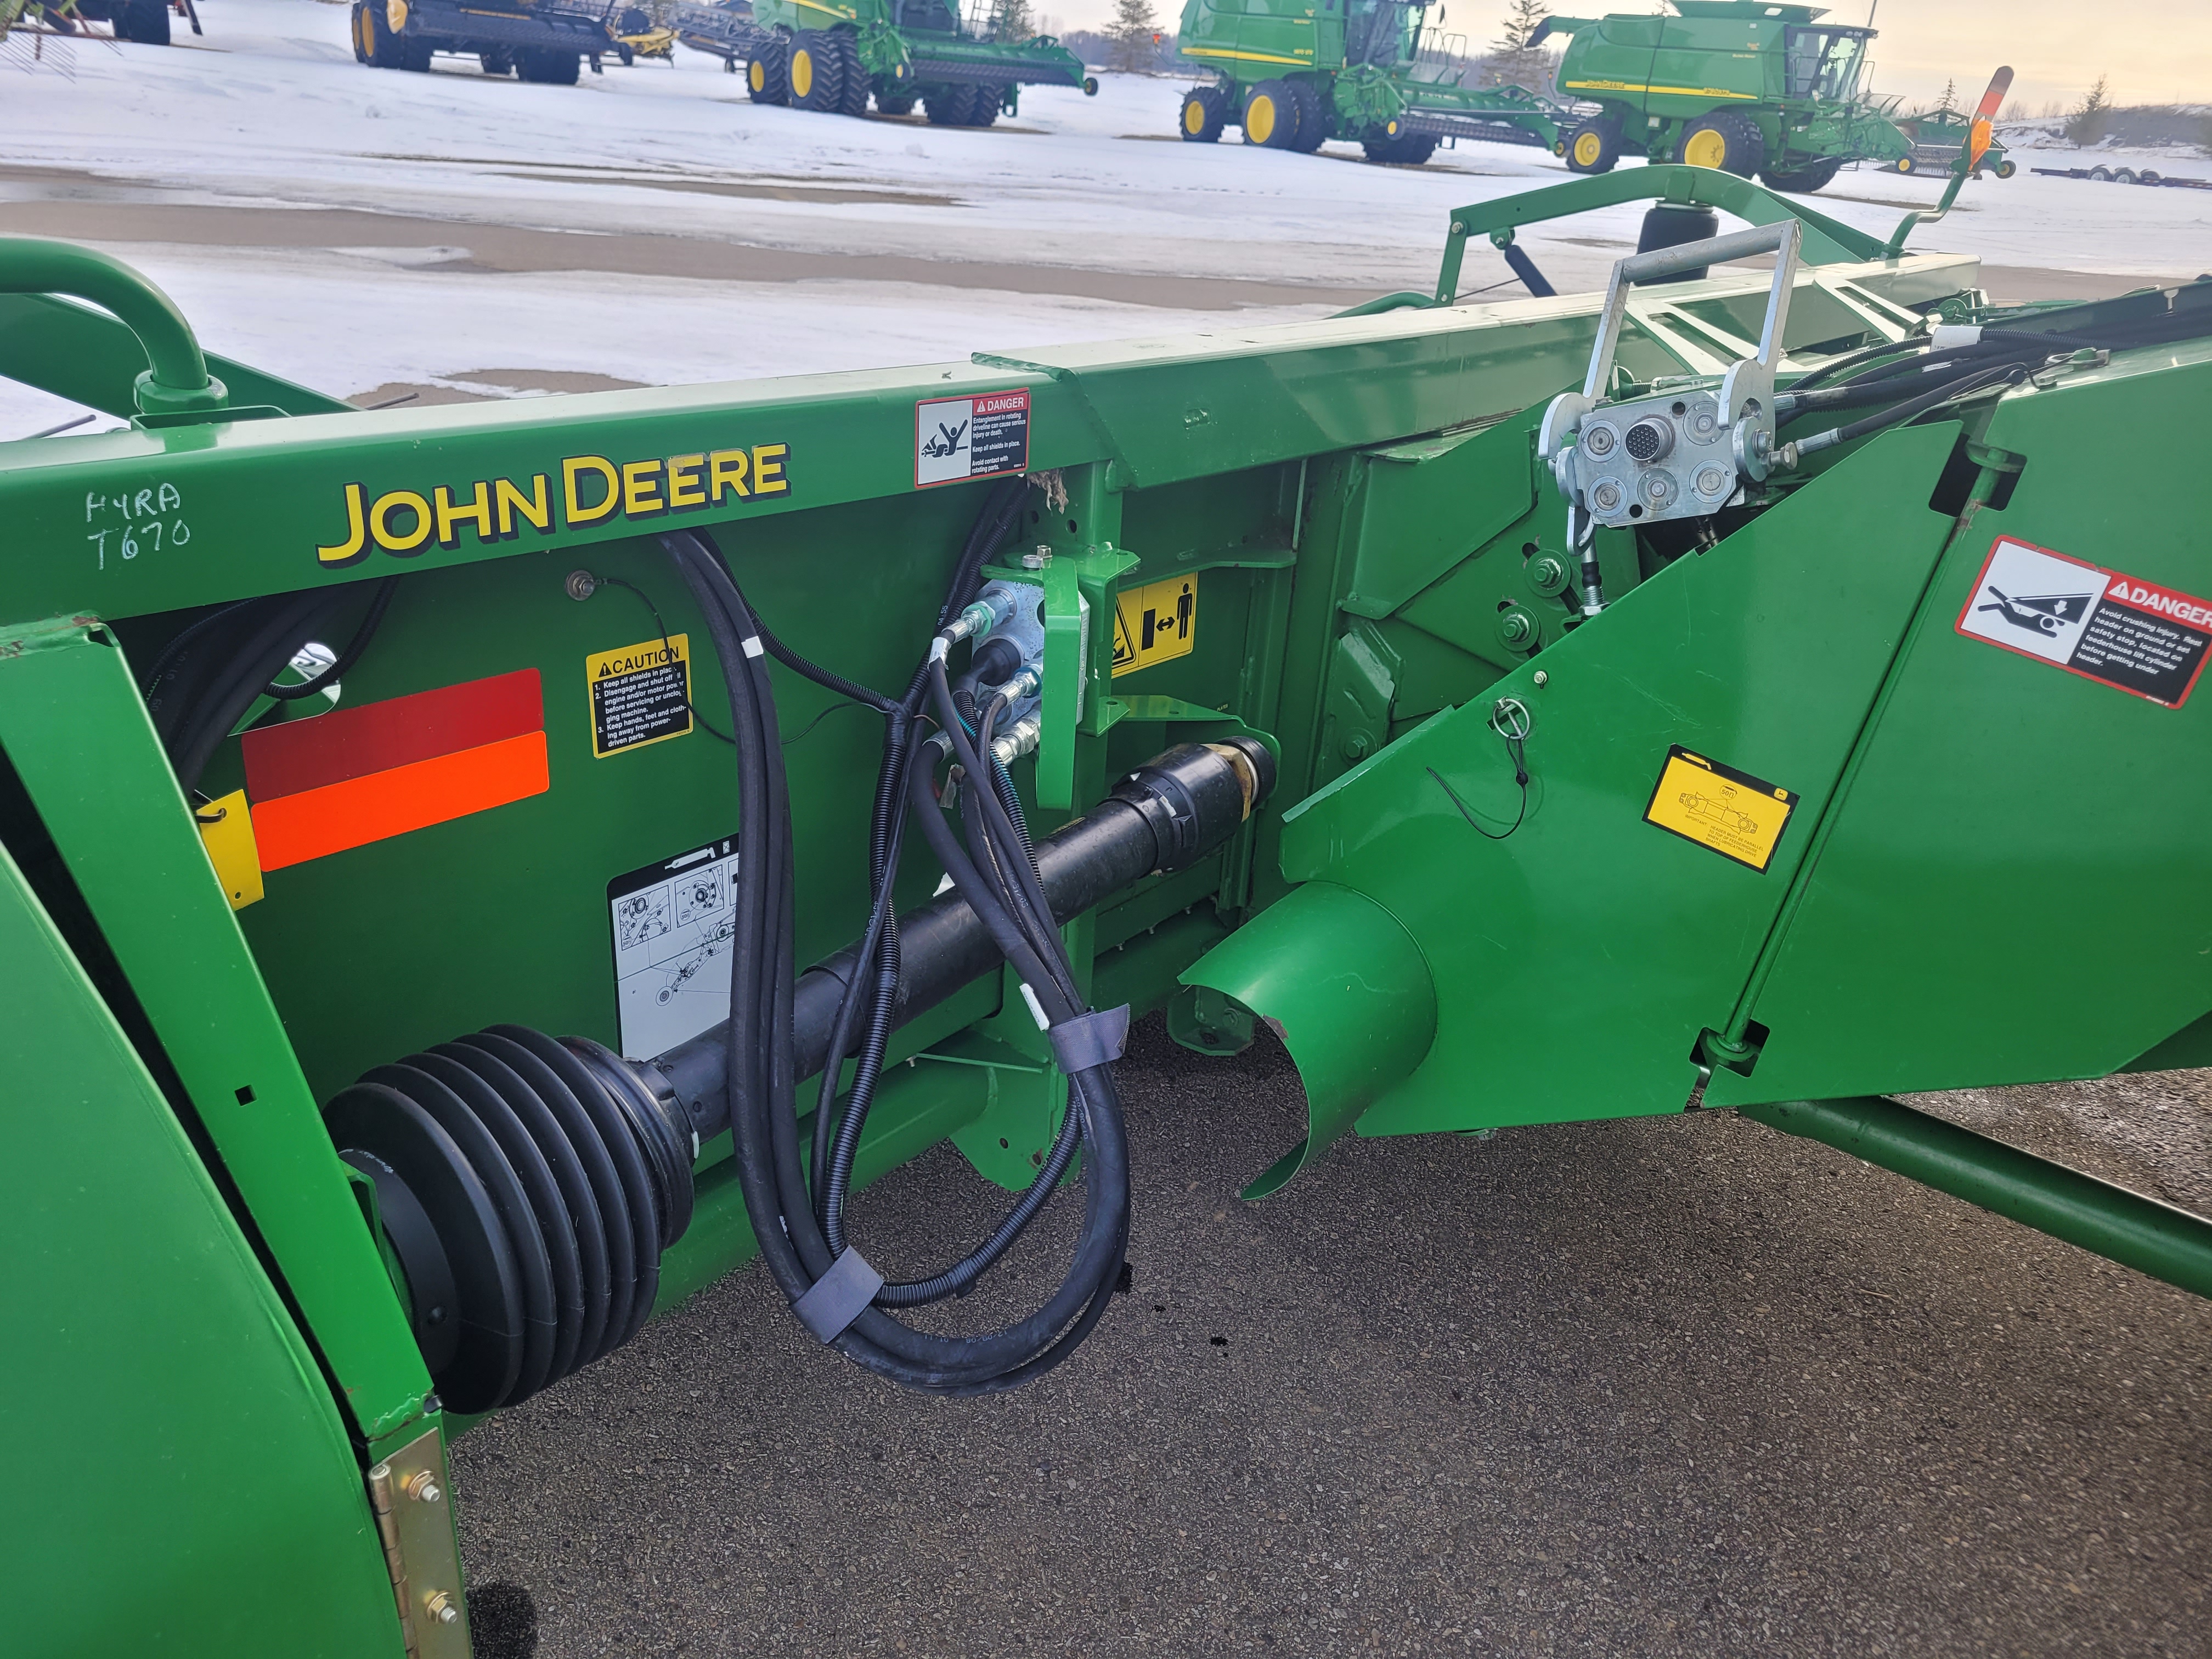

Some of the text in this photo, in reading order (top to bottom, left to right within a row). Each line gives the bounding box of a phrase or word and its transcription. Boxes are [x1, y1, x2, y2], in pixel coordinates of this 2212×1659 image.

[988, 397, 1024, 411] DANGER
[973, 414, 1001, 424] Entanglement
[1009, 441, 1020, 449] place.
[972, 459, 984, 467] Avoid
[972, 464, 1000, 474] rotating parts.
[317, 443, 791, 567] JOHN DEERE
[87, 519, 190, 570] T670
[2098, 608, 2123, 620] Avoid
[2122, 616, 2156, 632] crushing
[2156, 627, 2180, 640] injury.
[2090, 625, 2115, 639] safety
[2116, 635, 2137, 647] stop,
[2139, 642, 2170, 657] located
[2094, 617, 2123, 630] header
[2135, 631, 2166, 645] ground
[2175, 645, 2191, 654] set
[613, 646, 679, 674] CAUTION
[2076, 652, 2103, 666] header.
[2080, 644, 2159, 675] before getting under
[2085, 634, 2177, 670] feederhouse lift cylinder
[604, 680, 619, 689] Keep
[629, 672, 651, 682] shields
[659, 667, 677, 675] plac.
[604, 685, 636, 697] Disengage
[637, 680, 649, 689] and
[650, 677, 664, 686] shut
[605, 681, 684, 706] engine and/or motor powr
[606, 704, 625, 714] before
[627, 697, 654, 708] servicing
[606, 707, 648, 724] ging machine.
[607, 722, 623, 731] Keep
[624, 716, 644, 726] hands,
[670, 705, 686, 714] cloth-
[618, 727, 634, 736] away
[635, 723, 650, 731] from
[651, 718, 671, 729] power-
[608, 732, 646, 747] driven parts.
[1685, 814, 1707, 827] IMPORTANT:
[1711, 825, 1726, 834] HEADER
[1744, 839, 1764, 851] PARALLEL
[1706, 837, 1720, 847] SHAFTS
[1707, 833, 1719, 842] WHEN
[1719, 838, 1745, 853] LUBRICATING
[1729, 837, 1758, 853] FEEDERHOUSE
